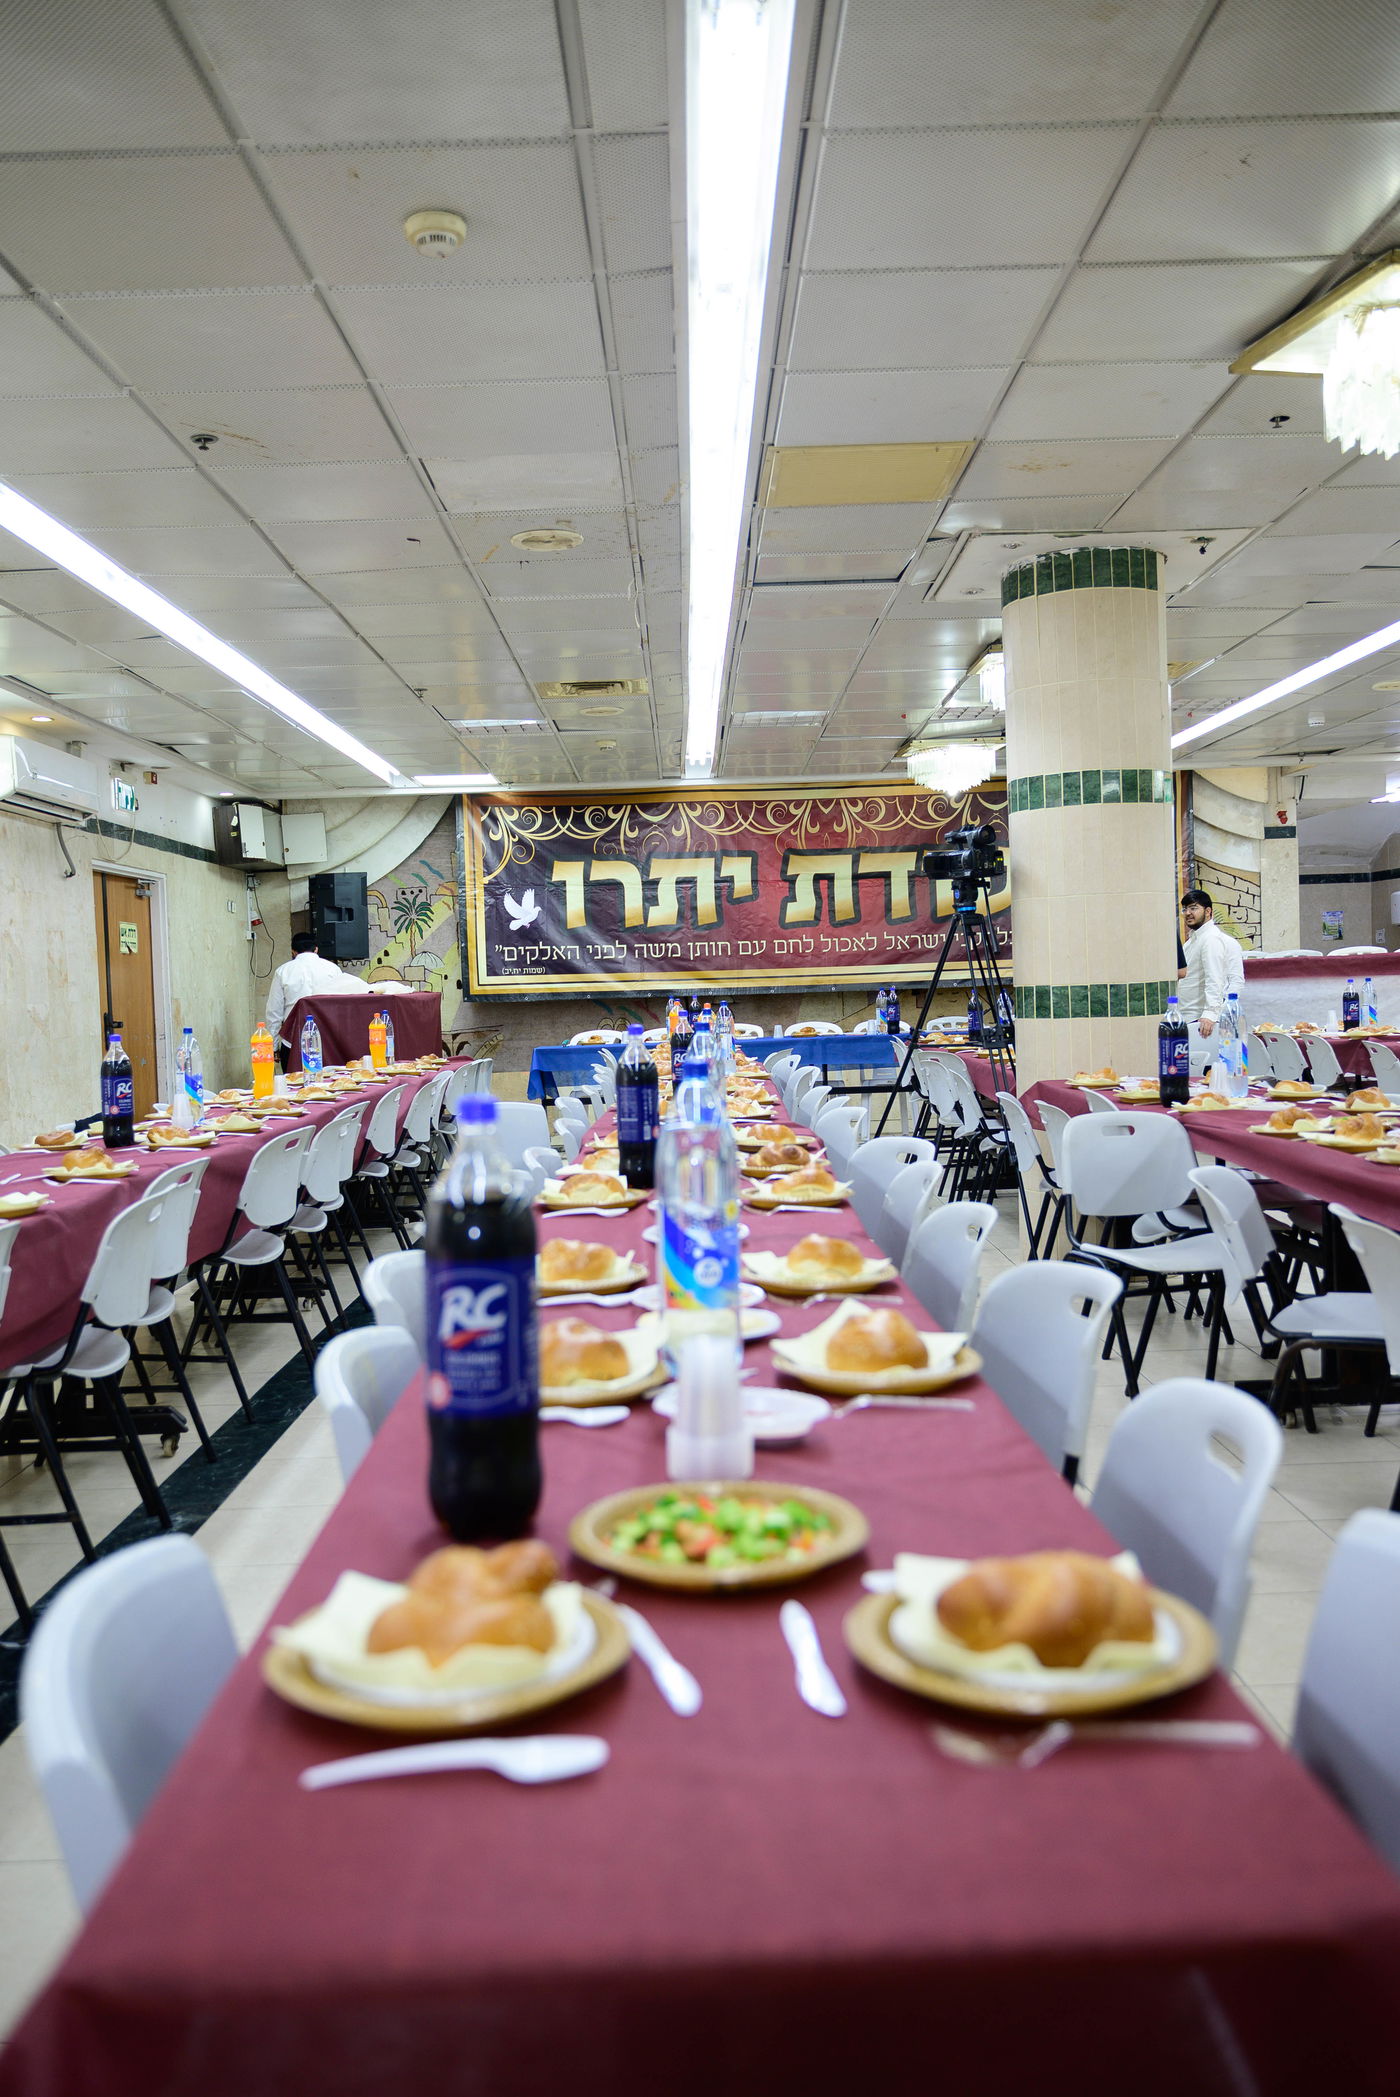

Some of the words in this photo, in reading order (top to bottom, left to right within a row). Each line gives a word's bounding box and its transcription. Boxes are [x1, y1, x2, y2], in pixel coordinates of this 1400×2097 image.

[551, 856, 753, 930] יתרו
[586, 940, 628, 960] לפני
[634, 942, 682, 959] משה
[686, 940, 732, 960] חותן
[738, 939, 767, 957] עם
[773, 934, 815, 954] לחם
[821, 932, 878, 953] לאכול
[883, 931, 945, 951] ישראל
[1174, 1043, 1189, 1057] RC
[116, 1082, 132, 1097] RC
[440, 1284, 507, 1340] RC
